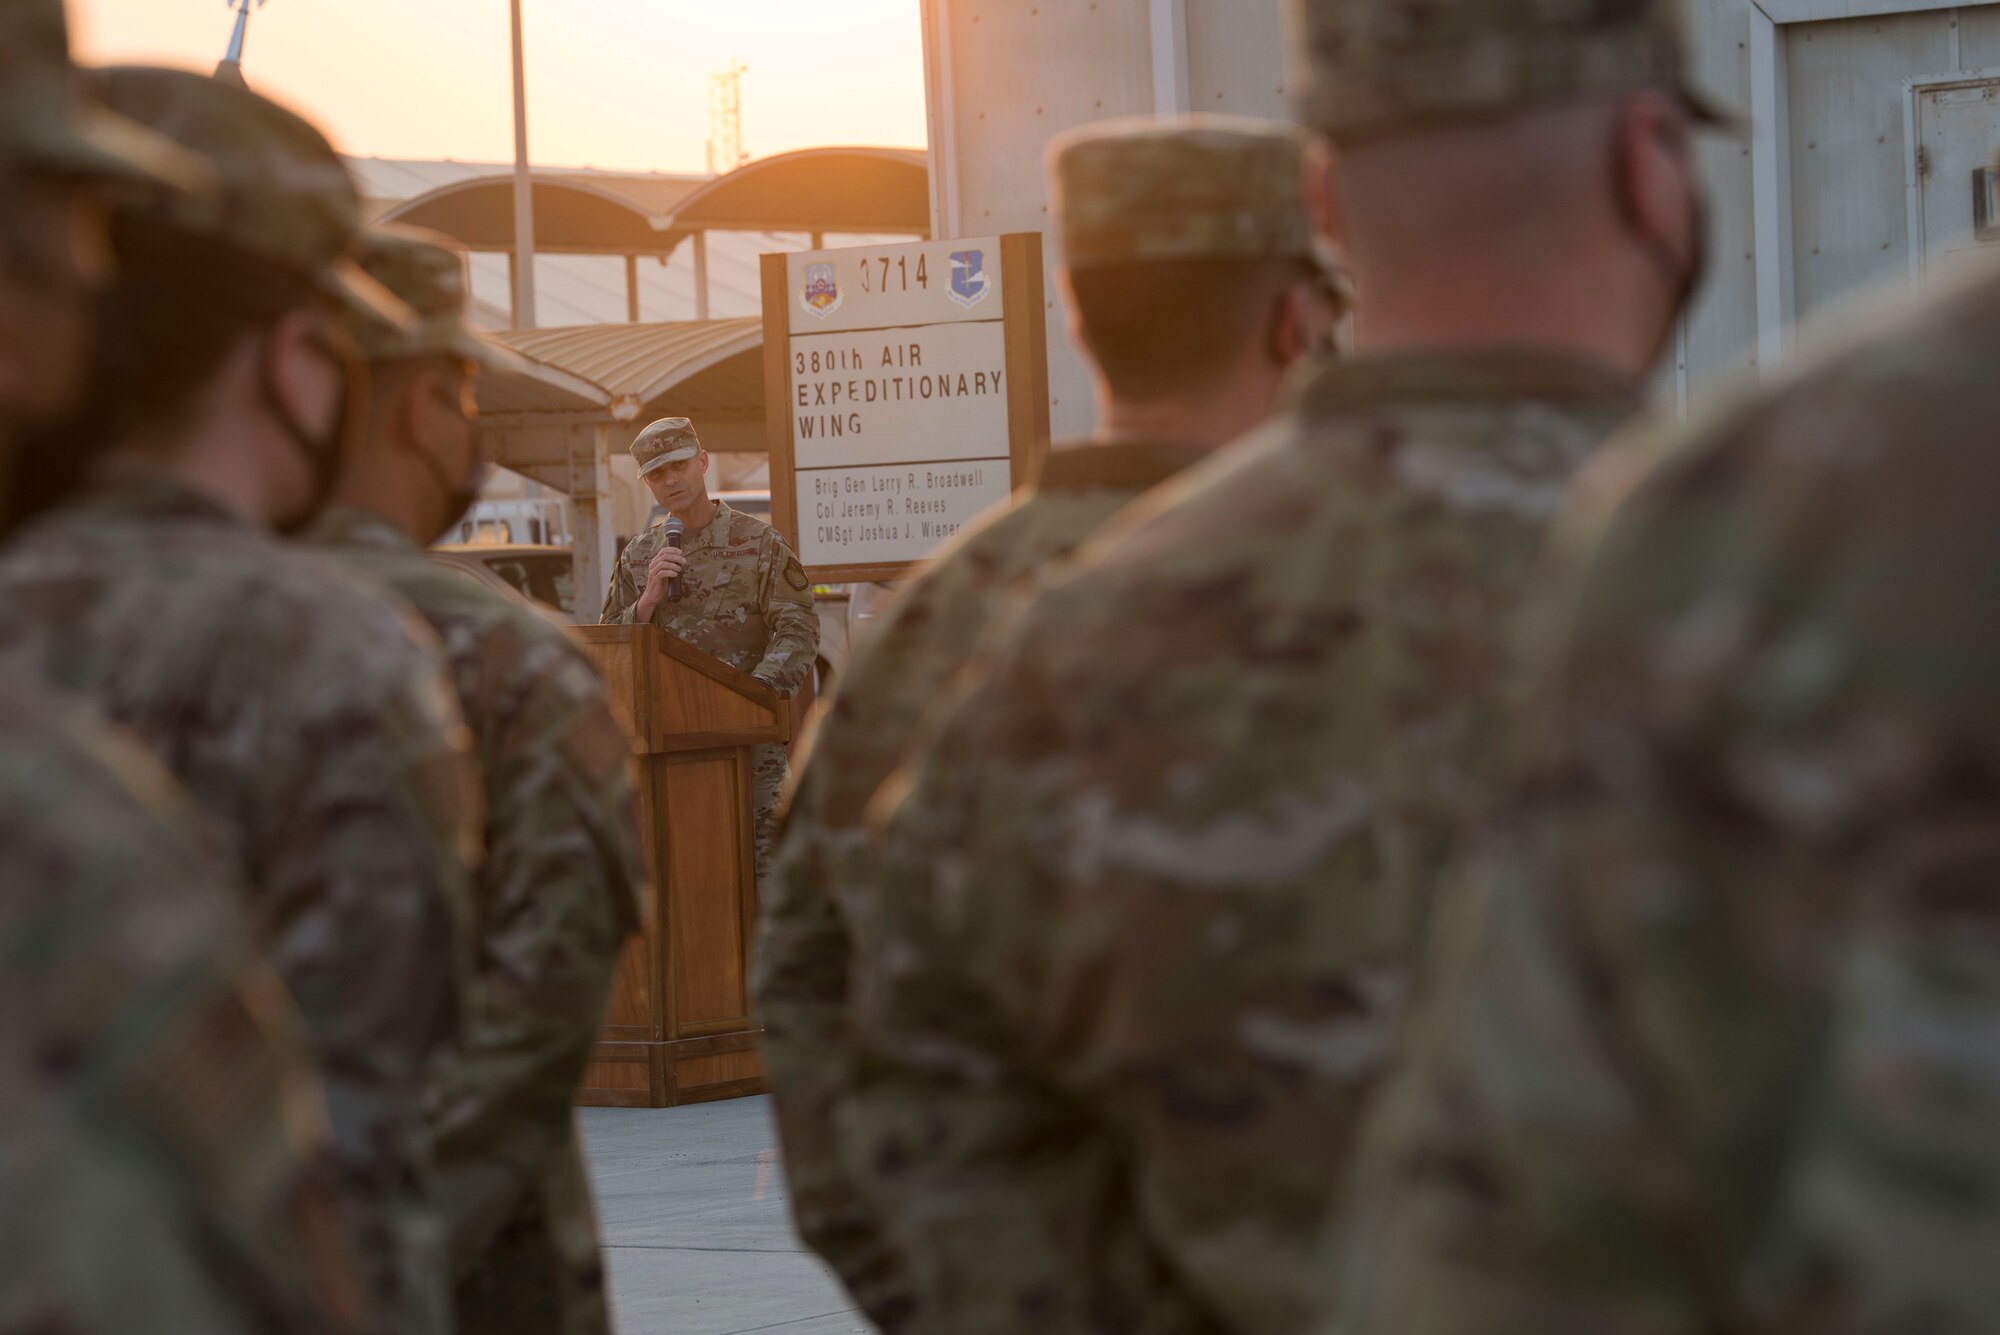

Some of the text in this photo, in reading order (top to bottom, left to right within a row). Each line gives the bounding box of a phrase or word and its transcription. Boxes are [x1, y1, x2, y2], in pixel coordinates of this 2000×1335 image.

[796, 344, 921, 375] 380th AIR
[798, 370, 1001, 406] EXPEDITIONARY
[799, 413, 862, 439] WING
[815, 470, 983, 498] Brig Gen Larry R. Broadwell
[816, 498, 946, 520] Col Jeremy R. Reeves
[818, 526, 853, 546] CMSgt
[859, 524, 898, 541] Joshua
[904, 523, 914, 540] J.
